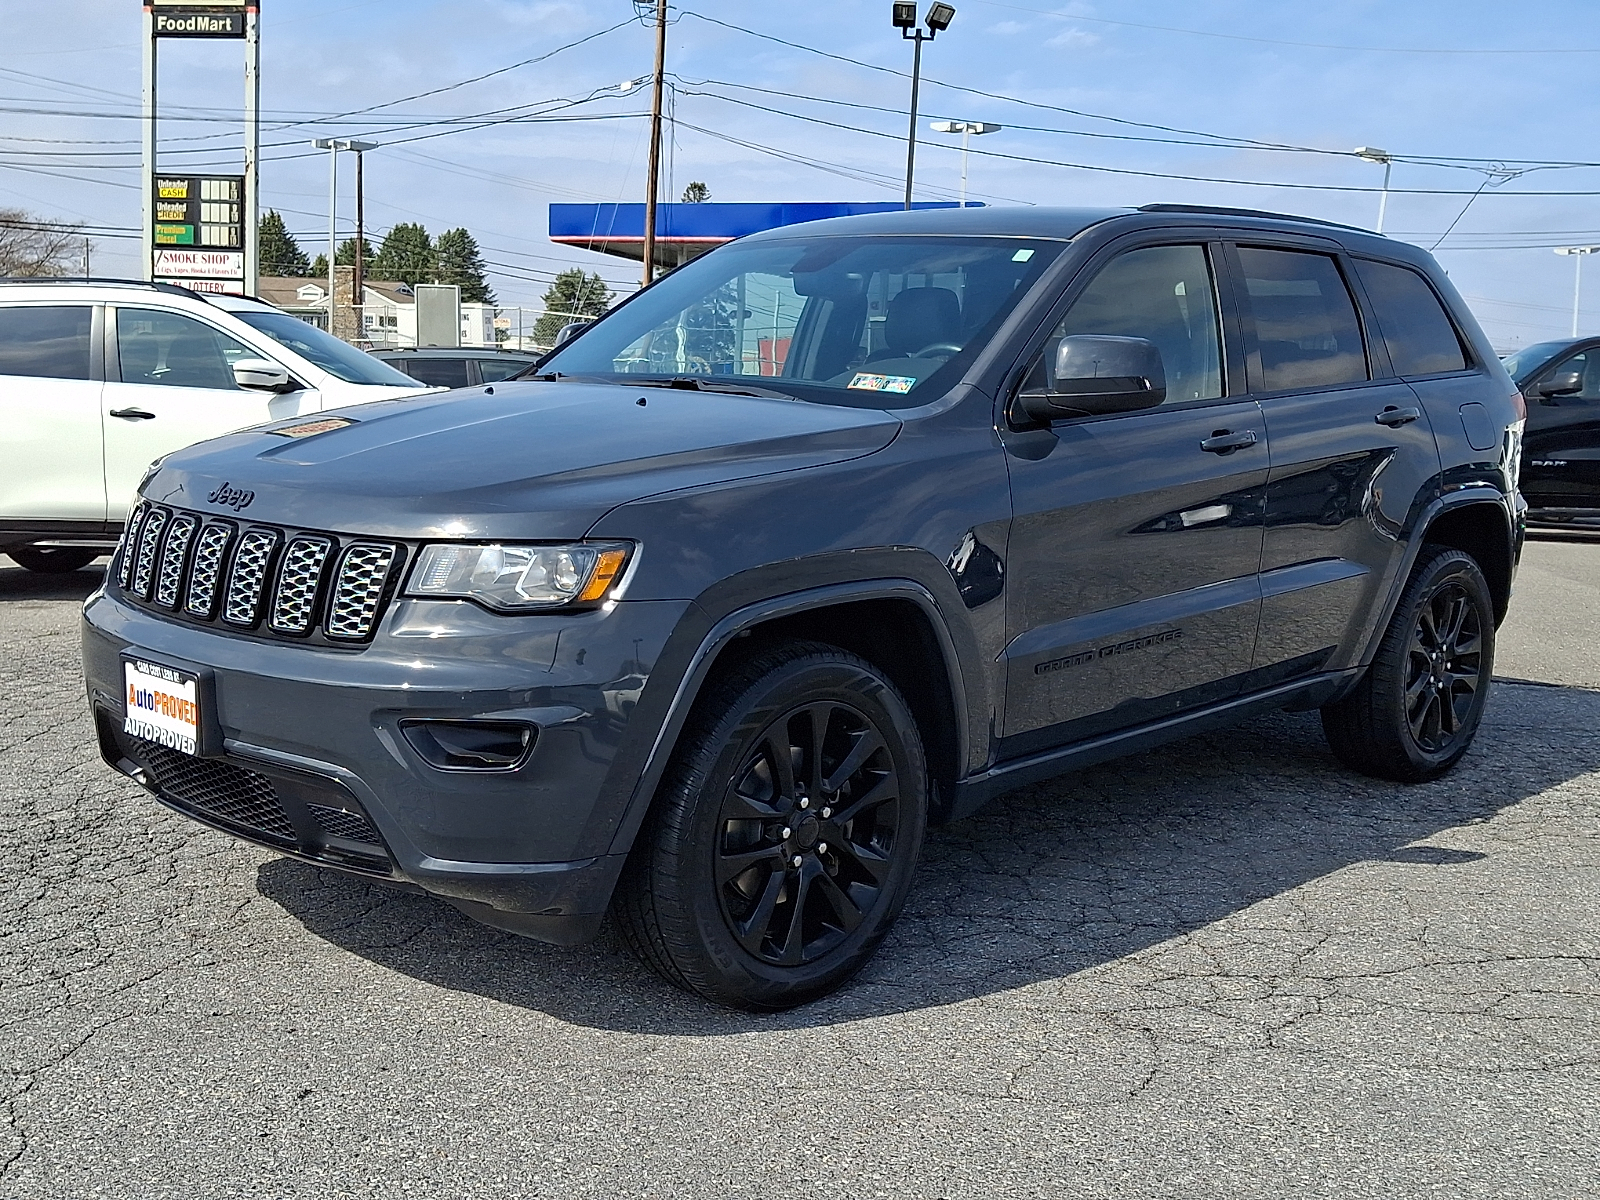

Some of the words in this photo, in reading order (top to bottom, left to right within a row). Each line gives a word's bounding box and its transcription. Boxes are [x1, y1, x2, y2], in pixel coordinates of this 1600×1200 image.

[157, 180, 188, 189] Unleaded
[161, 189, 184, 197] CASH
[156, 202, 187, 212] Unleaded
[157, 211, 185, 219] CREDIT
[163, 253, 199, 264] SMOKE
[201, 254, 230, 265] SHOP
[188, 282, 226, 293] LOTTERY
[206, 482, 256, 513] Jeep
[1034, 650, 1095, 675] GRAND
[1099, 628, 1183, 659] CHEROKEE
[129, 684, 199, 726] AutoPROVED
[123, 717, 196, 756] AUTOPROVED
